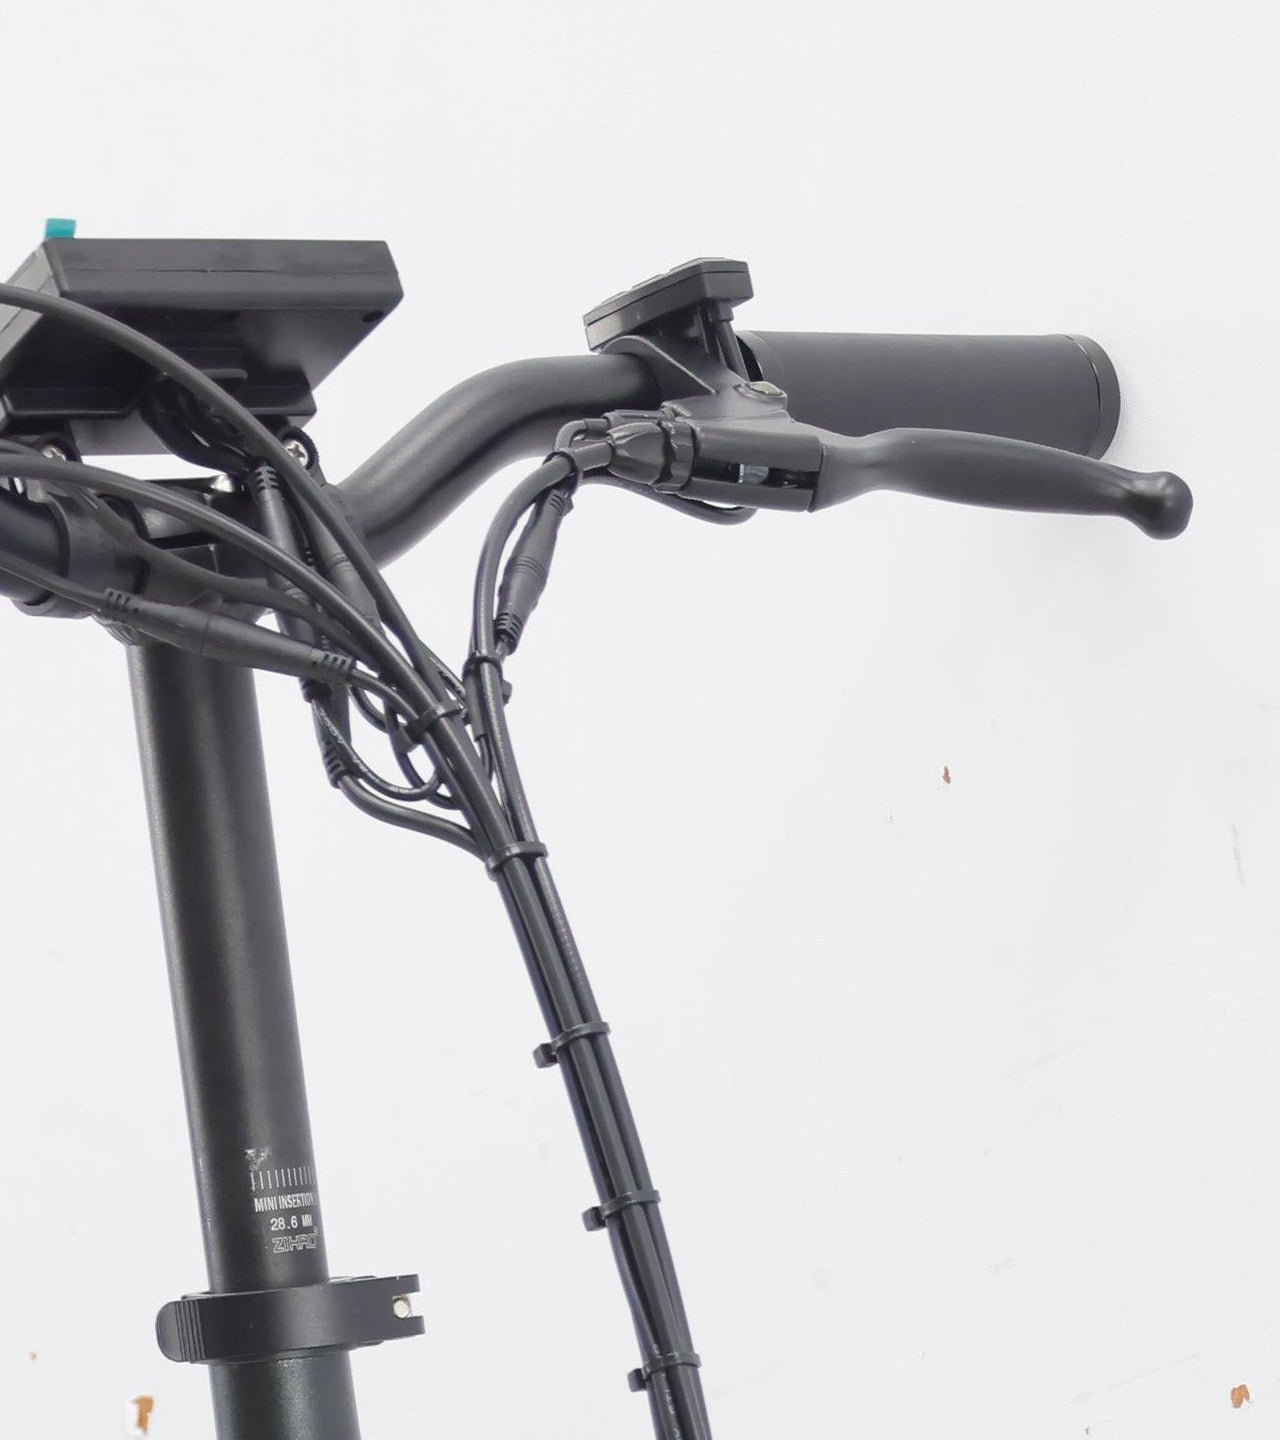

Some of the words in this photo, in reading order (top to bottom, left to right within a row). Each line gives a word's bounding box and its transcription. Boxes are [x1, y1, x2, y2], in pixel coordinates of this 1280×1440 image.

[253, 1195, 278, 1213] MINI
[270, 1215, 298, 1231] 28.6
[301, 1213, 313, 1227] MM
